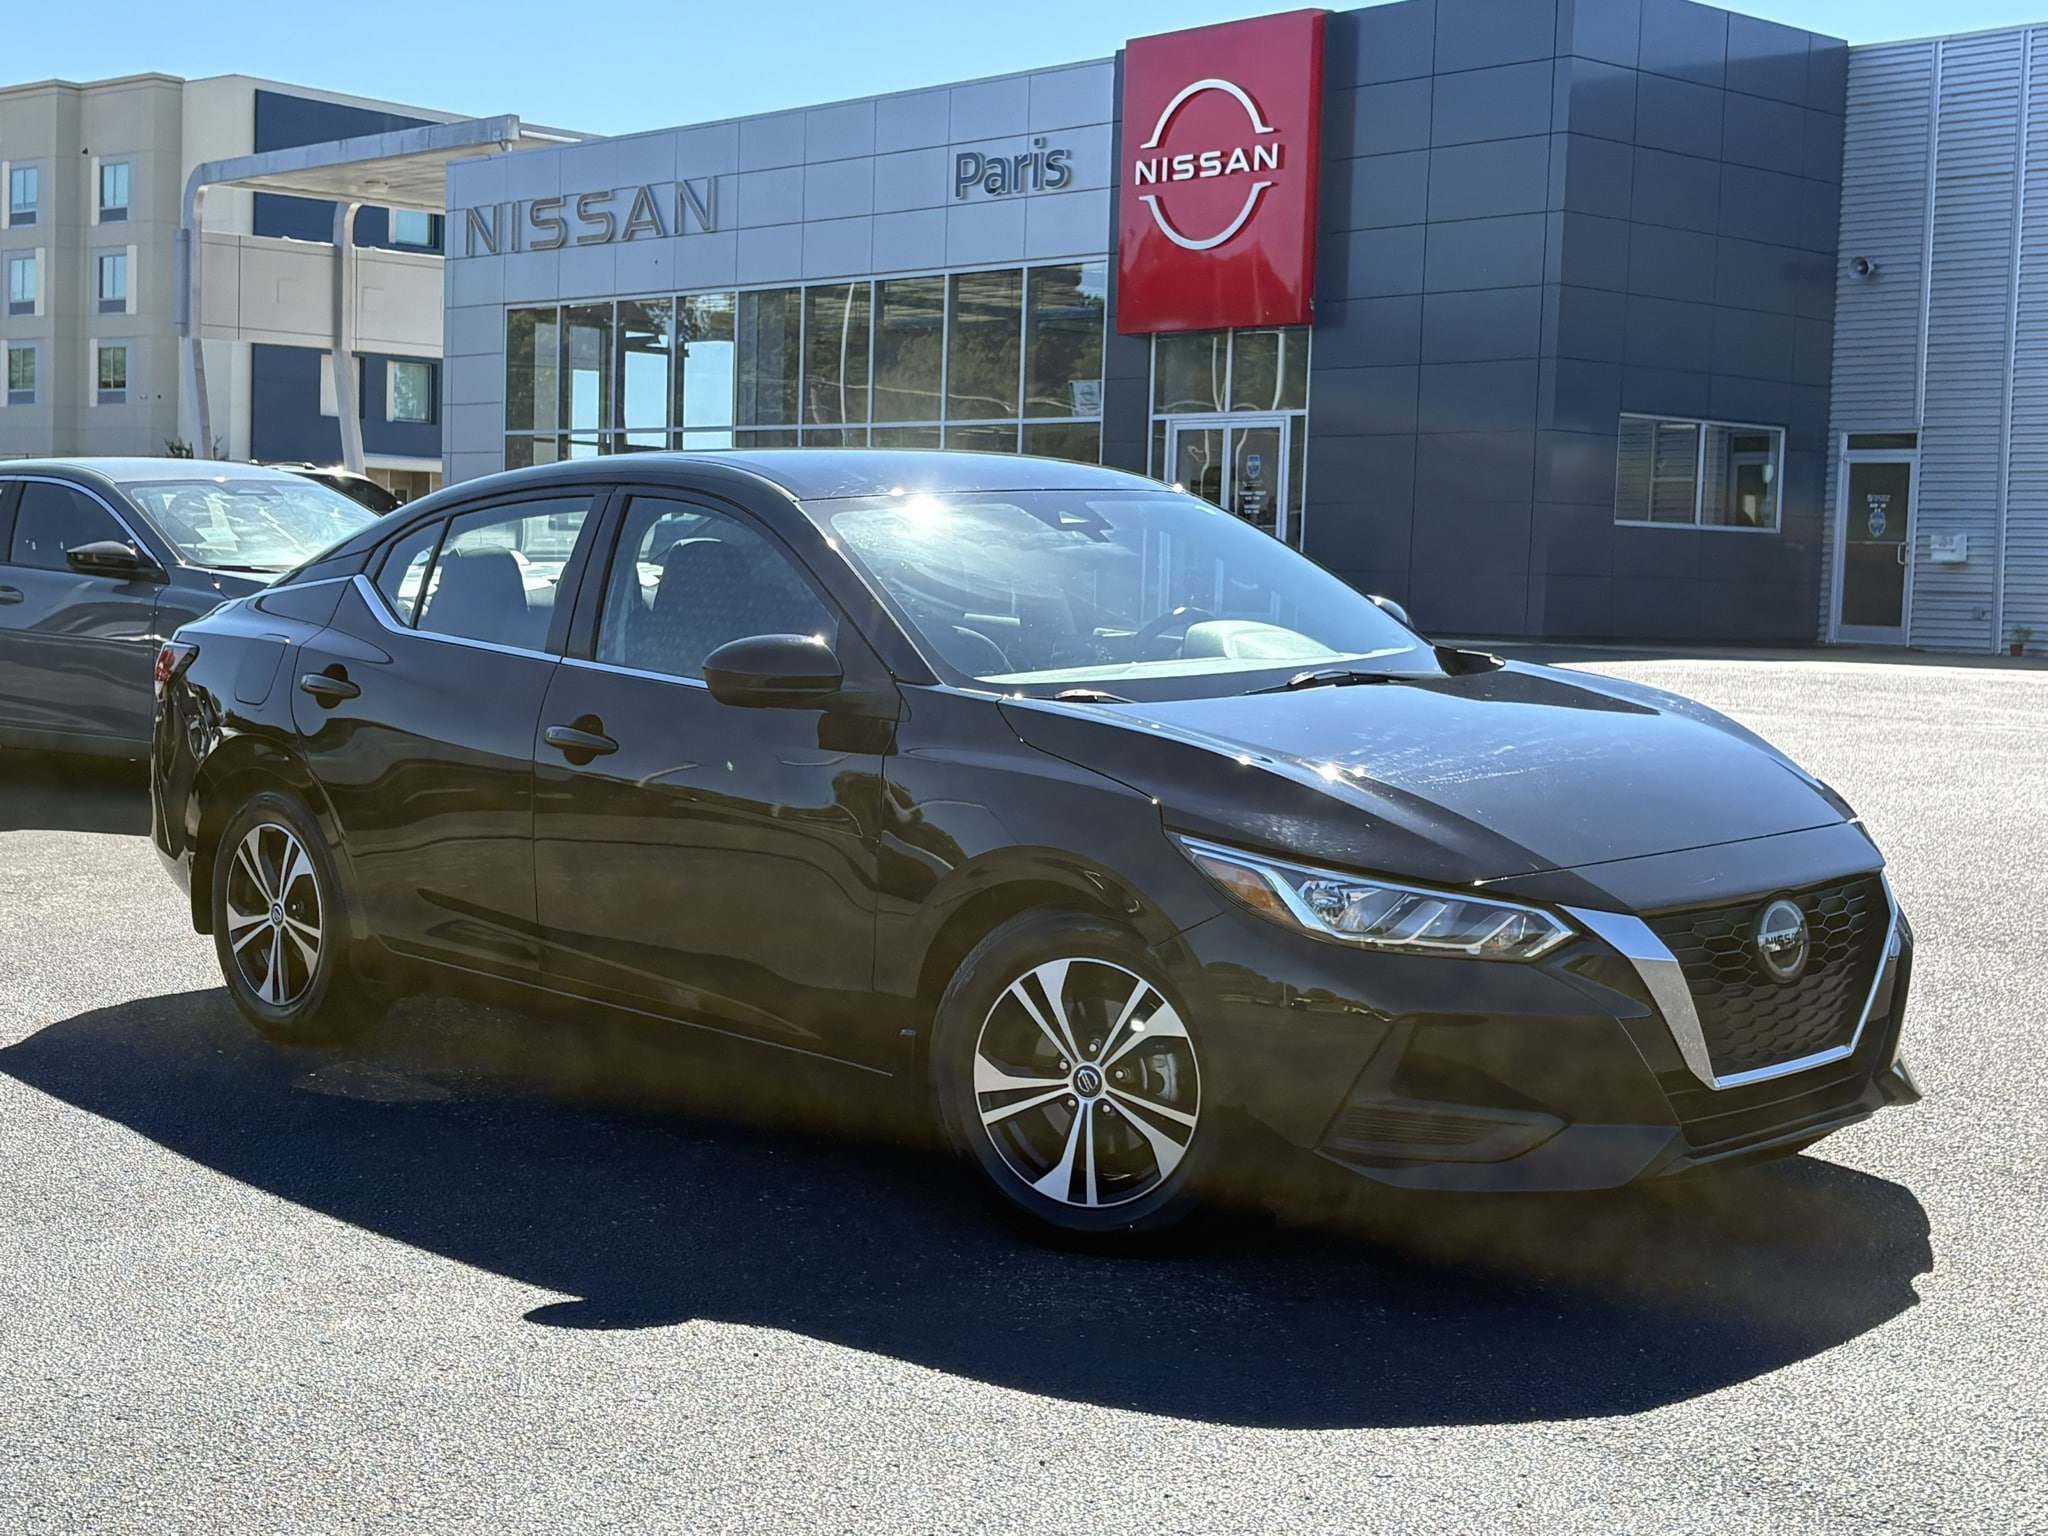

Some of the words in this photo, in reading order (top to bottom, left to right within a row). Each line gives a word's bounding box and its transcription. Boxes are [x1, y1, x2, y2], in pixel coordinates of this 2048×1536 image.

[956, 136, 1071, 199] Paris
[1135, 143, 1278, 185] NISSAN
[464, 176, 719, 256] NISSAN
[1764, 930, 1804, 948] NISSA
